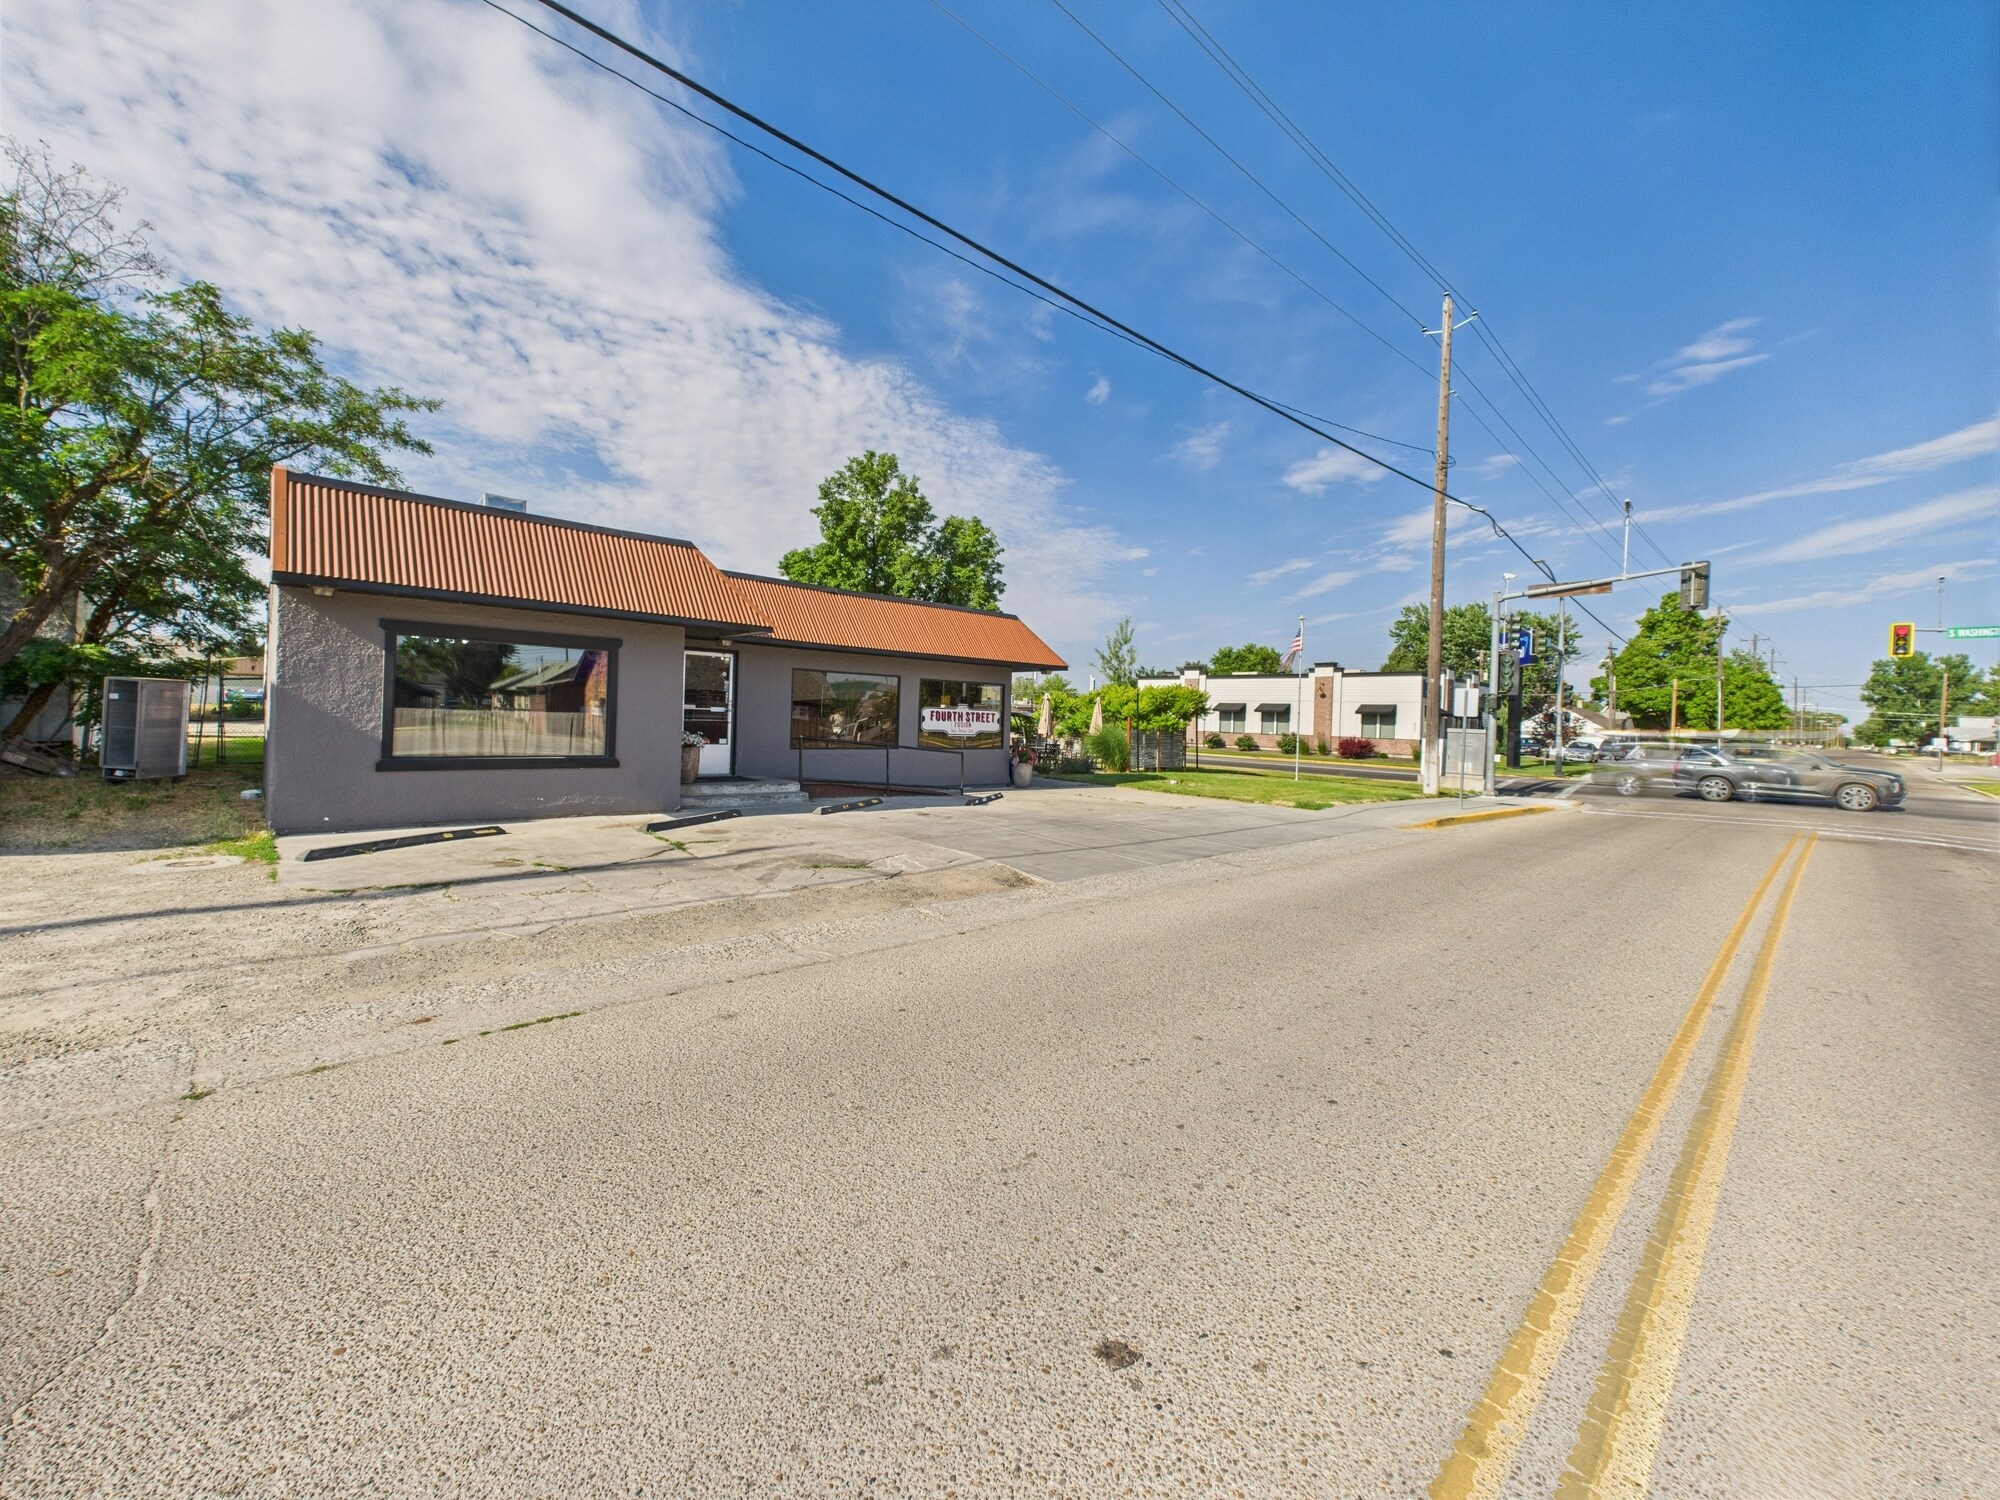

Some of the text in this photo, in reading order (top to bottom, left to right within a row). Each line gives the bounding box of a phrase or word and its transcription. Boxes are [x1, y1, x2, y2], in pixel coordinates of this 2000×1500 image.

[1949, 629, 1956, 637] S
[930, 710, 996, 723] FOURTH STREET
